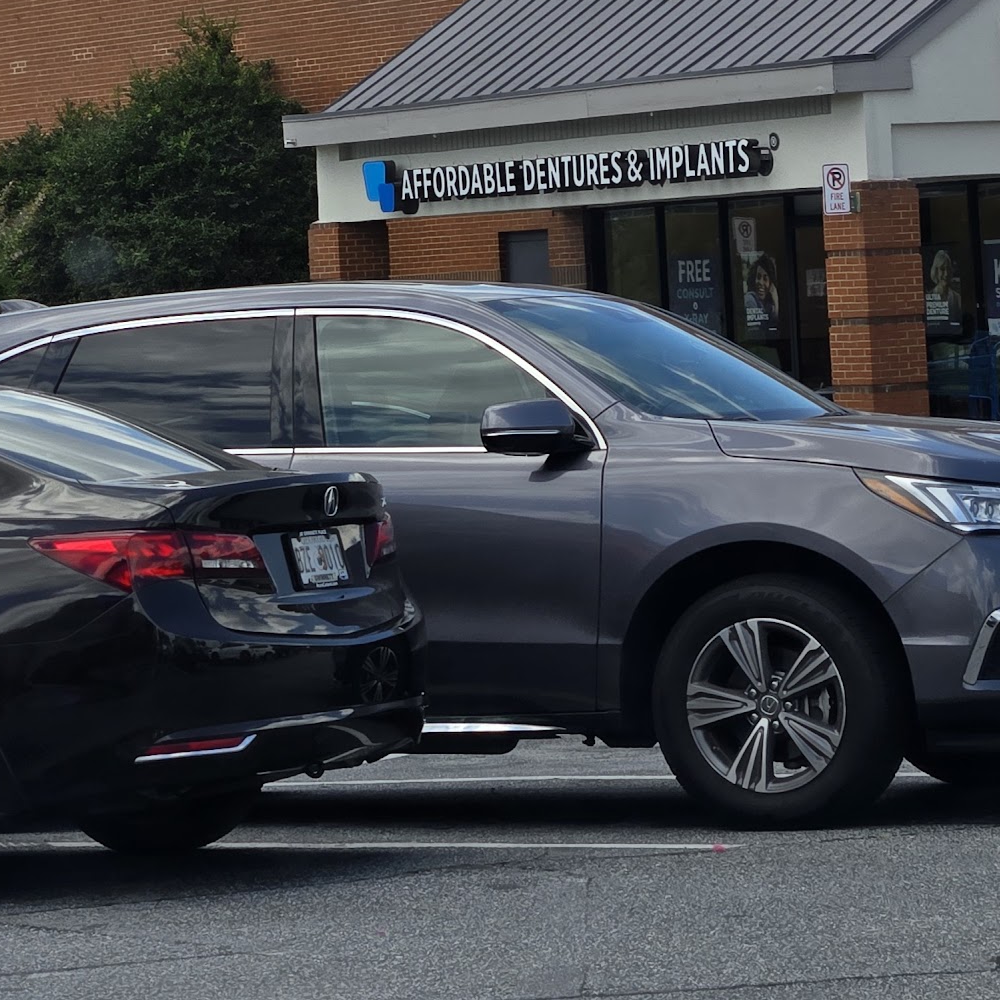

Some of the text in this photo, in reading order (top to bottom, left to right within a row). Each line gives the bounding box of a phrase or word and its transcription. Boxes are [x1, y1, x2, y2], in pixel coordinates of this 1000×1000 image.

[402, 138, 750, 200] AFFORDABLE DENTURES & IMPLANTS
[830, 192, 844, 200] FIRE
[830, 202, 846, 210] LANE
[678, 259, 711, 282] FREE
[676, 287, 714, 299] CONSULT
[294, 546, 316, 573] BZE
